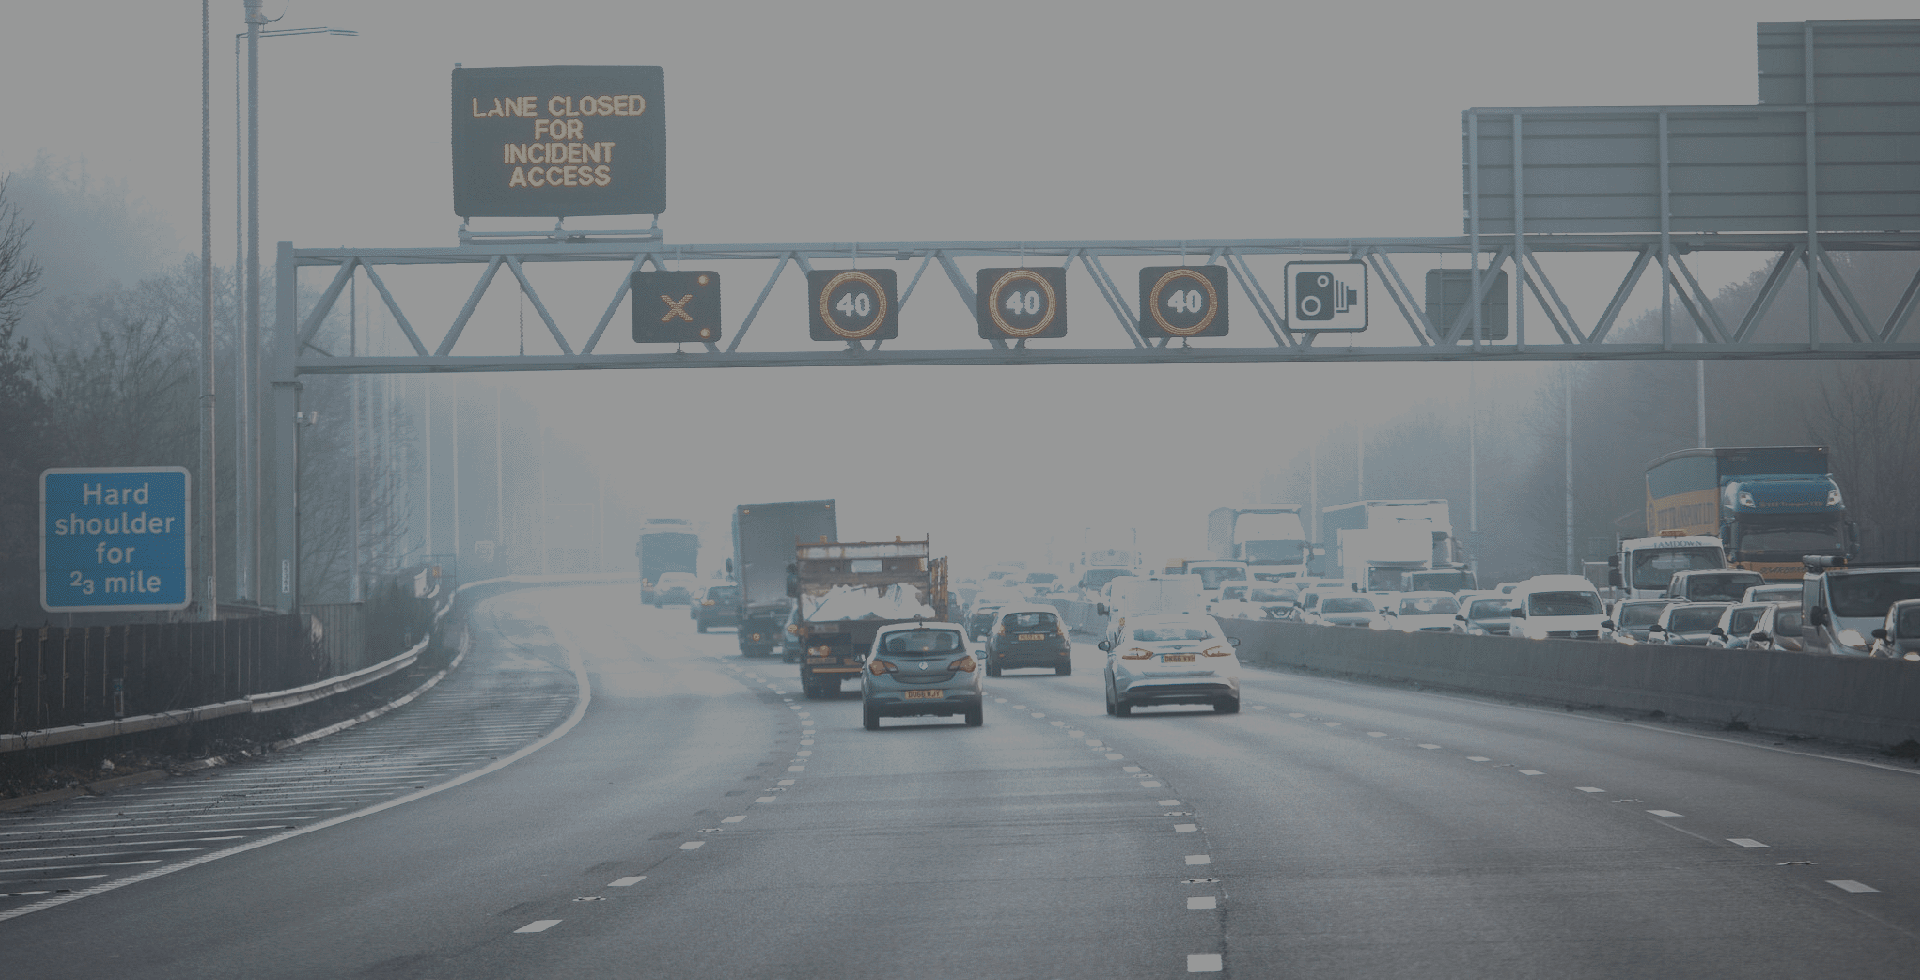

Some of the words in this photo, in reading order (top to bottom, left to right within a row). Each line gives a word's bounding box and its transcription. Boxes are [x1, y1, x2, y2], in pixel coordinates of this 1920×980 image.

[473, 96, 538, 118] LANE
[548, 95, 646, 117] CLOSED
[535, 118, 584, 140] FOR
[504, 142, 616, 164] INCIDENT
[508, 165, 612, 188] ACCESS
[836, 292, 871, 317] 40
[1005, 290, 1040, 315] 40
[1167, 289, 1202, 314] 40
[83, 482, 149, 505] Hard
[55, 511, 176, 536] shoulder
[96, 540, 136, 564] for
[105, 570, 162, 593] mile
